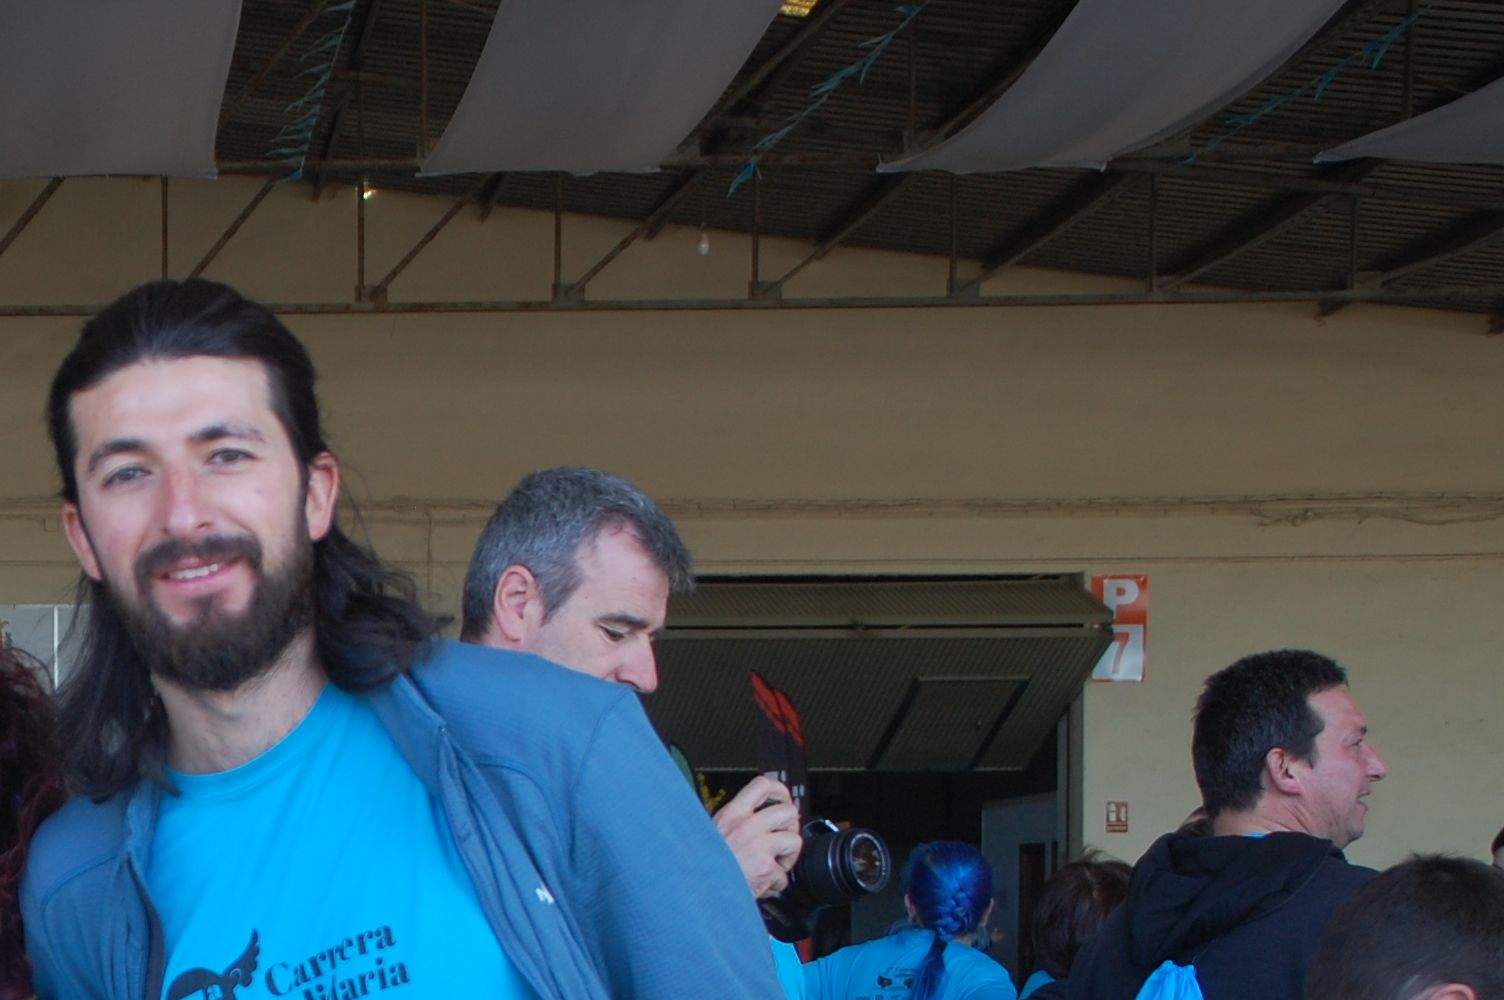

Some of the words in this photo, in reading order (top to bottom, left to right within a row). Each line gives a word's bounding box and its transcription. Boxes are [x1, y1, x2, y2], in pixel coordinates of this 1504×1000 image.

[1103, 579, 1139, 619] P
[1110, 632, 1130, 674] 7
[265, 925, 396, 996] Carrera
